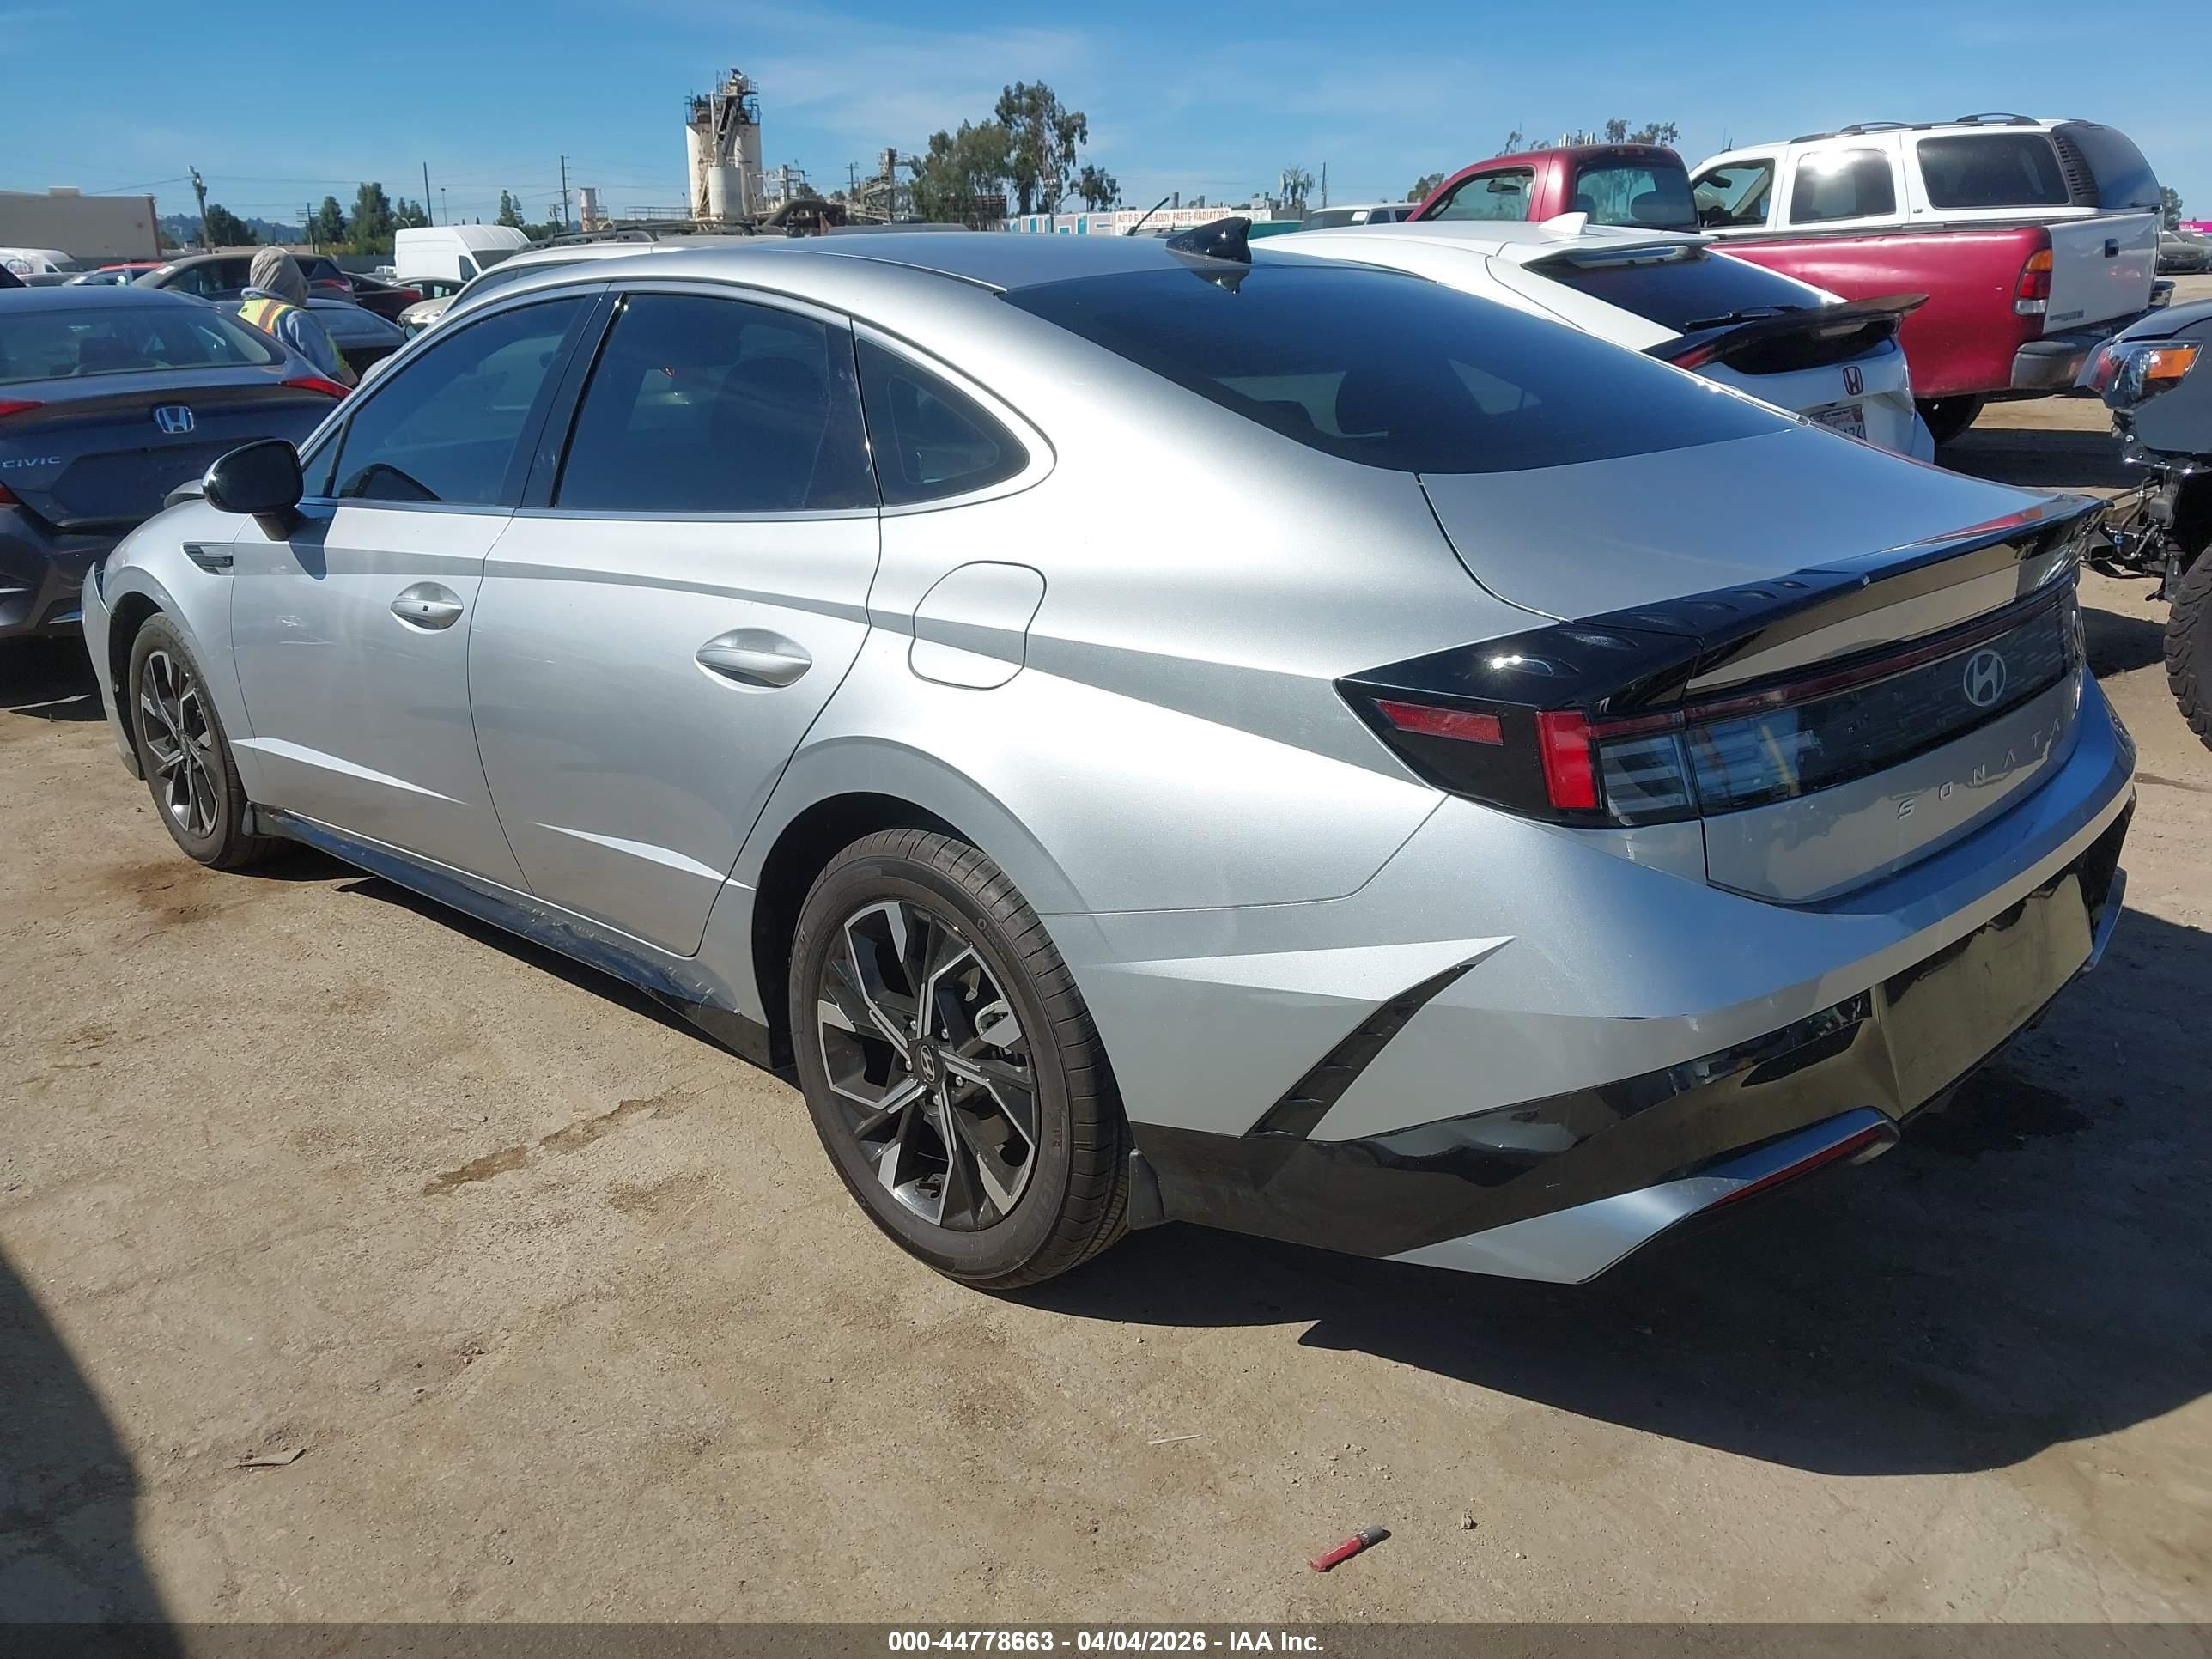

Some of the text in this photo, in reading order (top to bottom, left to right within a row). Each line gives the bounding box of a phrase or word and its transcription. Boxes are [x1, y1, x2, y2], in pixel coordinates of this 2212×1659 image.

[1117, 213, 1132, 223] AUTO
[2, 456, 61, 468] CIVIC
[1897, 718, 2061, 821] SONATA
